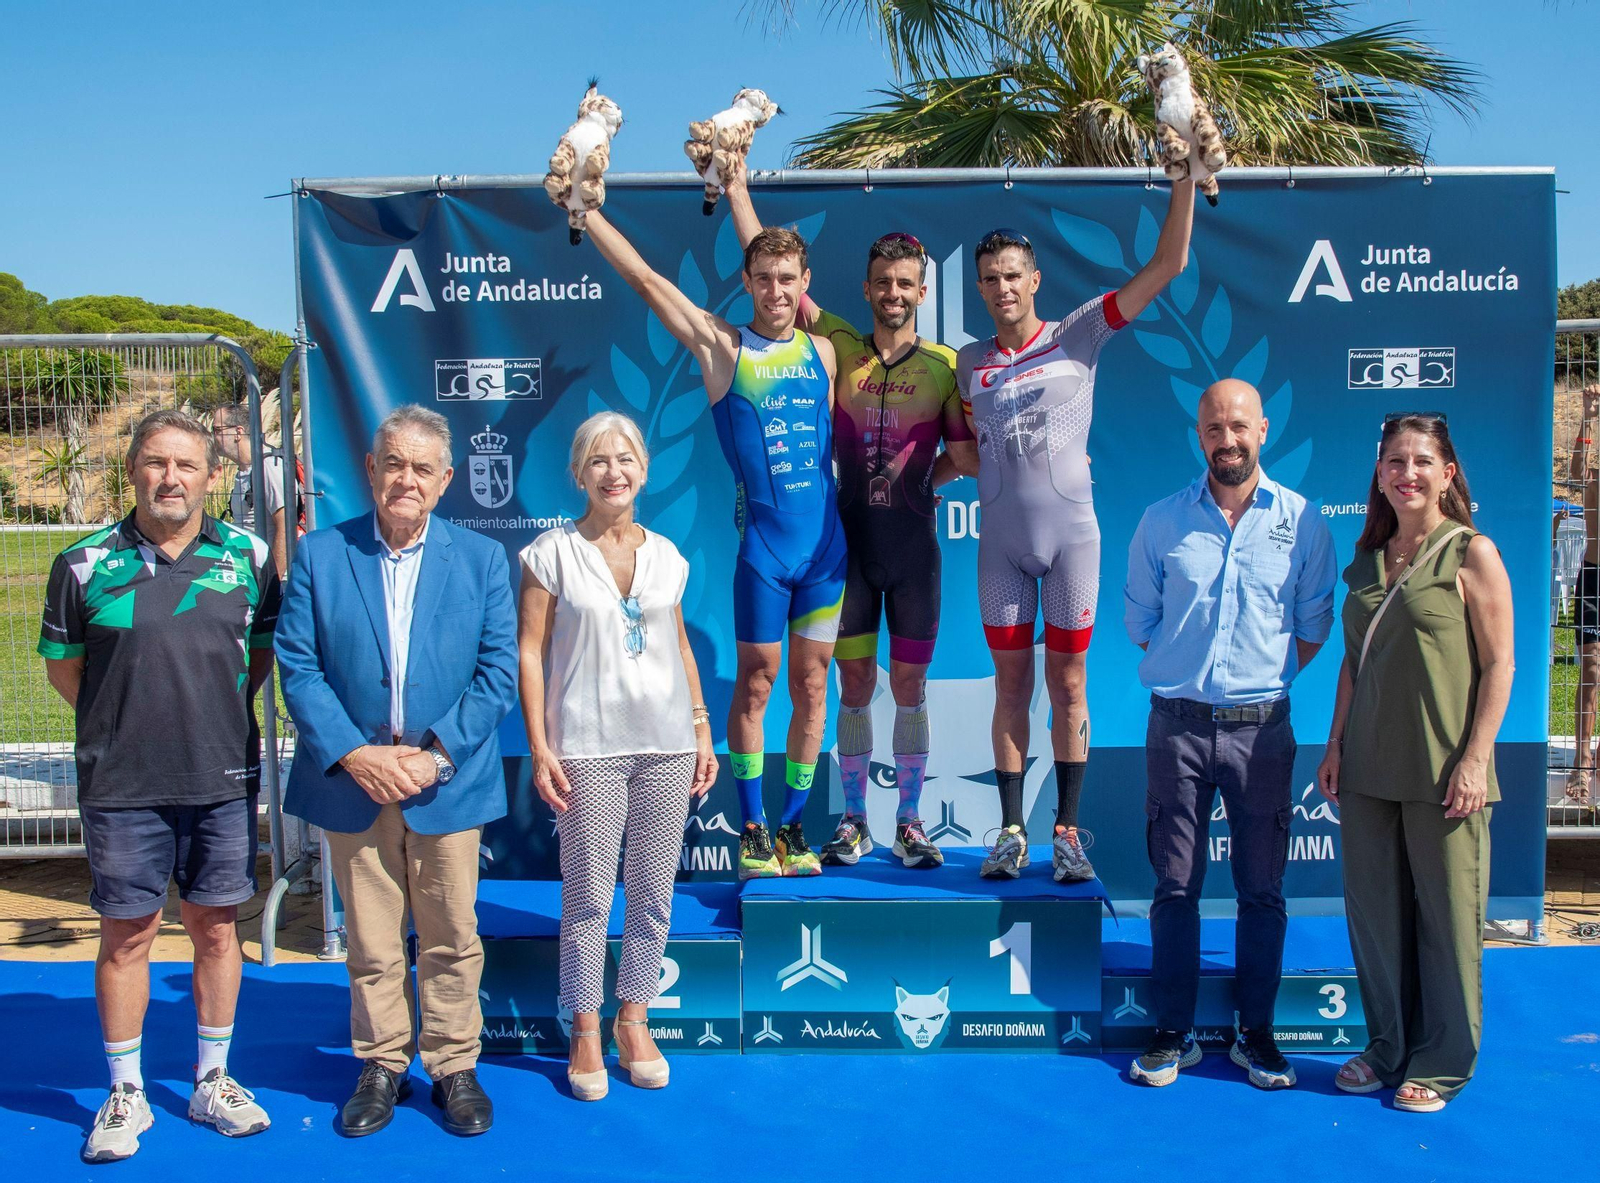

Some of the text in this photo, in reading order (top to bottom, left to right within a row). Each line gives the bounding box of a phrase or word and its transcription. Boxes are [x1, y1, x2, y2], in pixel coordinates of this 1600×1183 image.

[440, 252, 511, 274] Junta
[1360, 244, 1431, 266] Junta
[442, 274, 603, 303] de Andalucía
[1360, 266, 1519, 293] de Andalucía
[1349, 350, 1454, 360] Federación Andaluza de Triatlón
[436, 361, 540, 371] Federación Andaluza de Triatlón
[753, 364, 819, 381] VILLAZALA
[865, 406, 899, 429] TIZON
[989, 921, 1032, 995] 1
[647, 956, 681, 1009] 2
[1317, 983, 1347, 1020] 3
[480, 1022, 546, 1040] Andalucía
[649, 1026, 684, 1040] DOÑANA
[800, 1019, 882, 1040] Andalucía
[962, 1021, 1046, 1037] DESAFIO DOÑANA
[1273, 1031, 1324, 1041] DESAFIO DOÑANA
